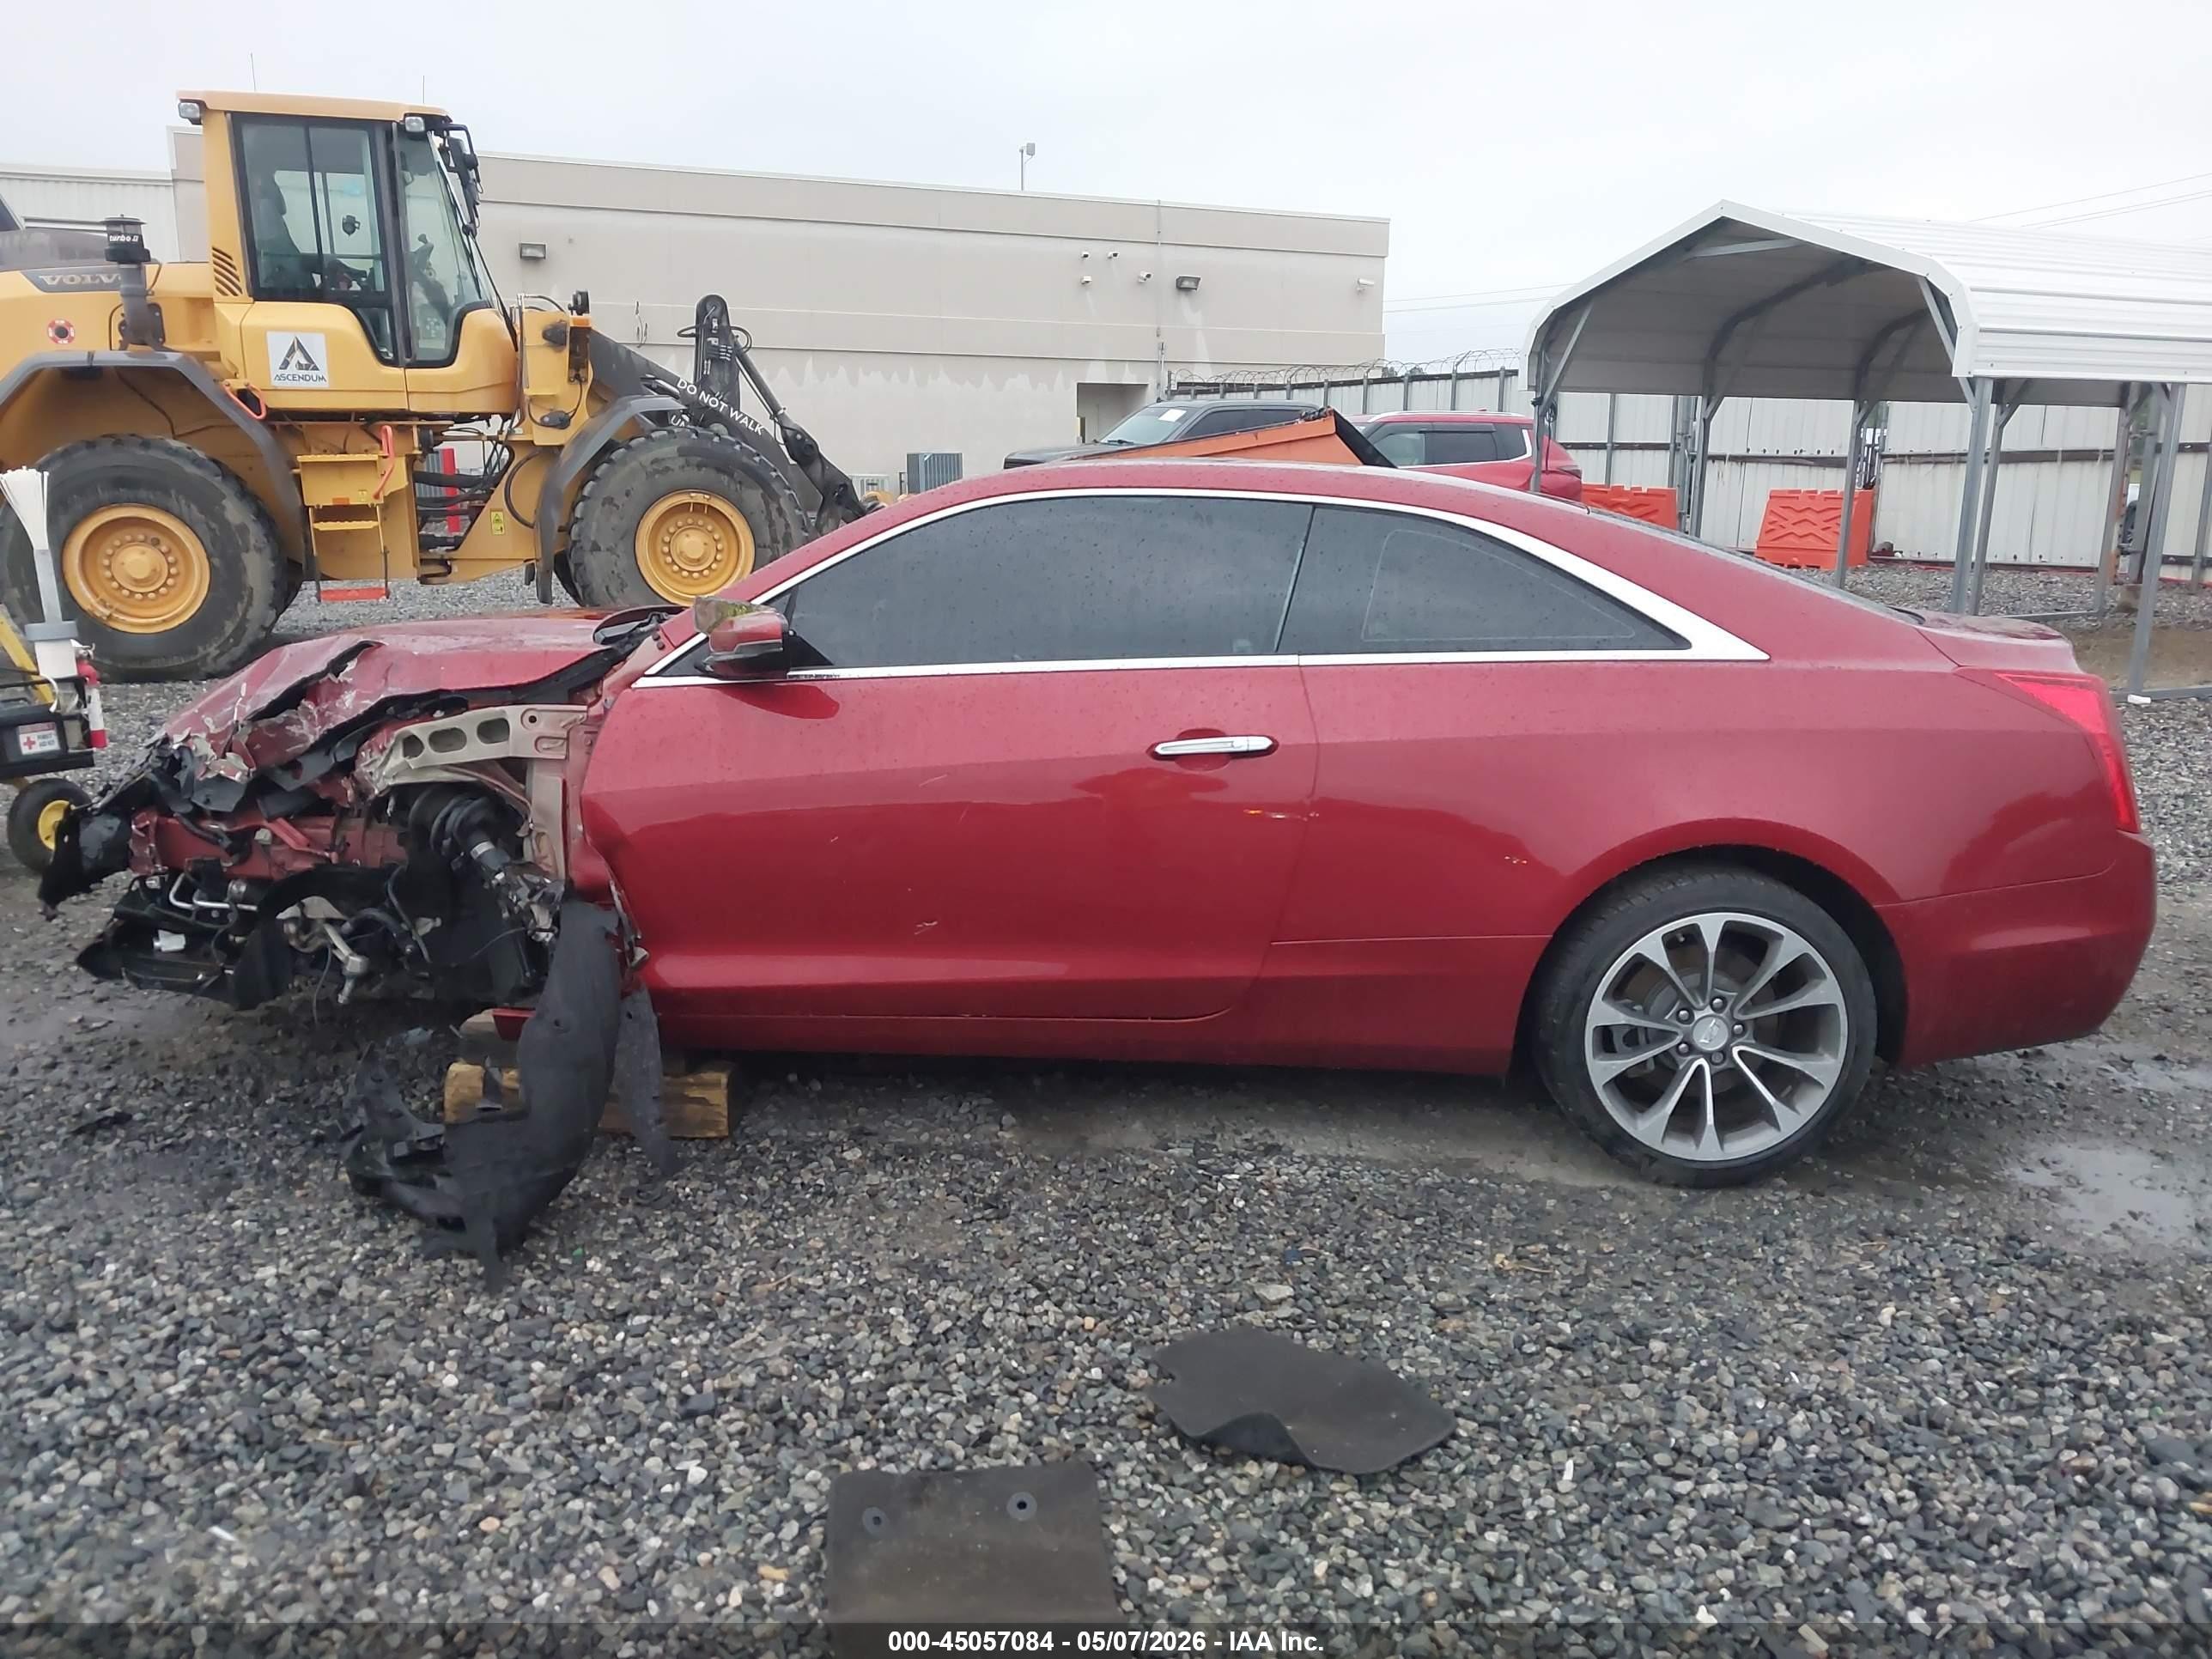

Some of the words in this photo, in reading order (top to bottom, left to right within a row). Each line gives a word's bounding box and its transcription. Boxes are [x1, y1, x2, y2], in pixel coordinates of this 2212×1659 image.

[109, 234, 131, 242] turbo
[40, 274, 122, 285] VOLV
[274, 374, 327, 382] ASCENDUM
[678, 378, 697, 395] DO
[699, 391, 727, 412] NOT
[730, 407, 764, 435] WALK
